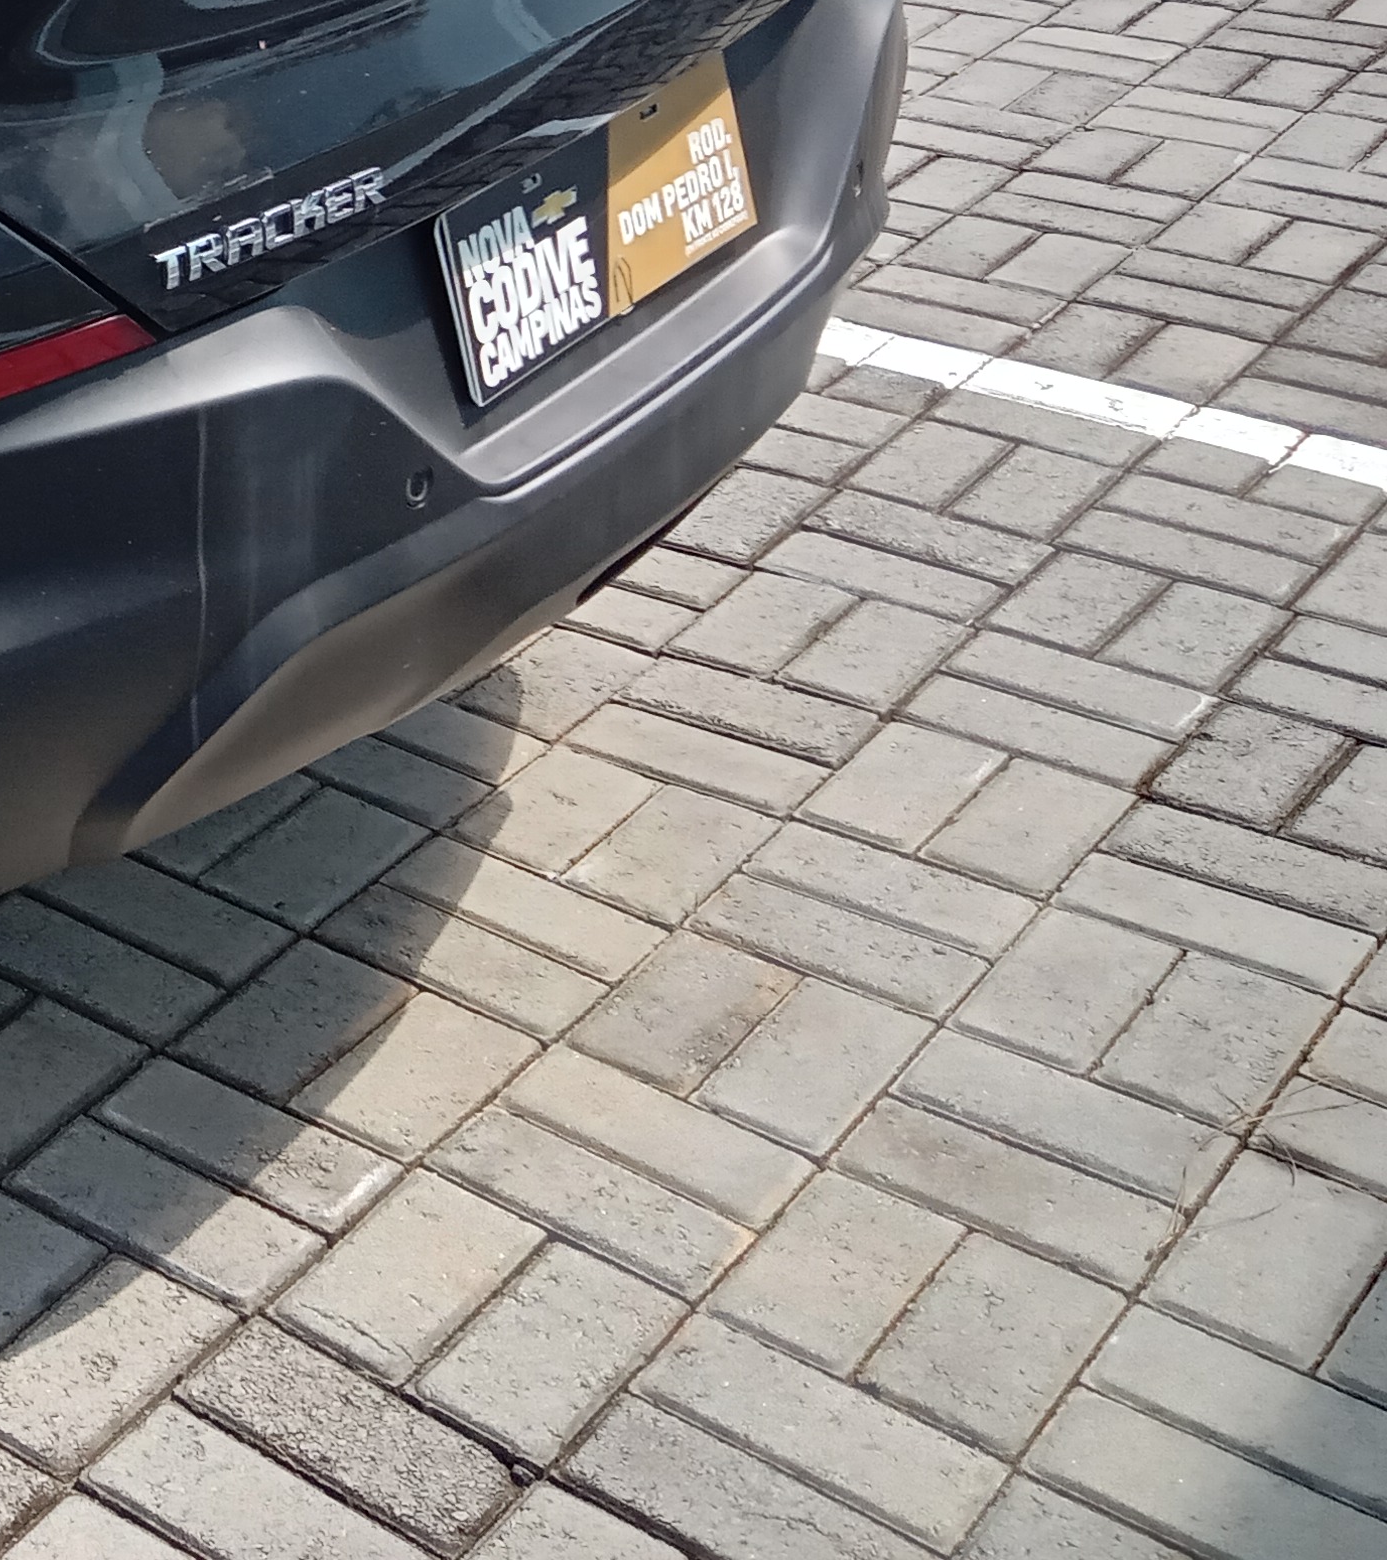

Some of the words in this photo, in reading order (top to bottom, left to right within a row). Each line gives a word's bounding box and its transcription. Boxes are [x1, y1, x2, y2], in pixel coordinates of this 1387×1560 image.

[687, 117, 732, 164] ROD.
[151, 166, 387, 290] TRACKER
[618, 191, 664, 245] DOM
[661, 155, 724, 218] PEDRO
[681, 198, 714, 243] KM
[712, 180, 745, 223] 128
[457, 205, 535, 288] NOVA
[468, 215, 596, 344] CODIVE
[479, 275, 603, 388] CAMPINAS
